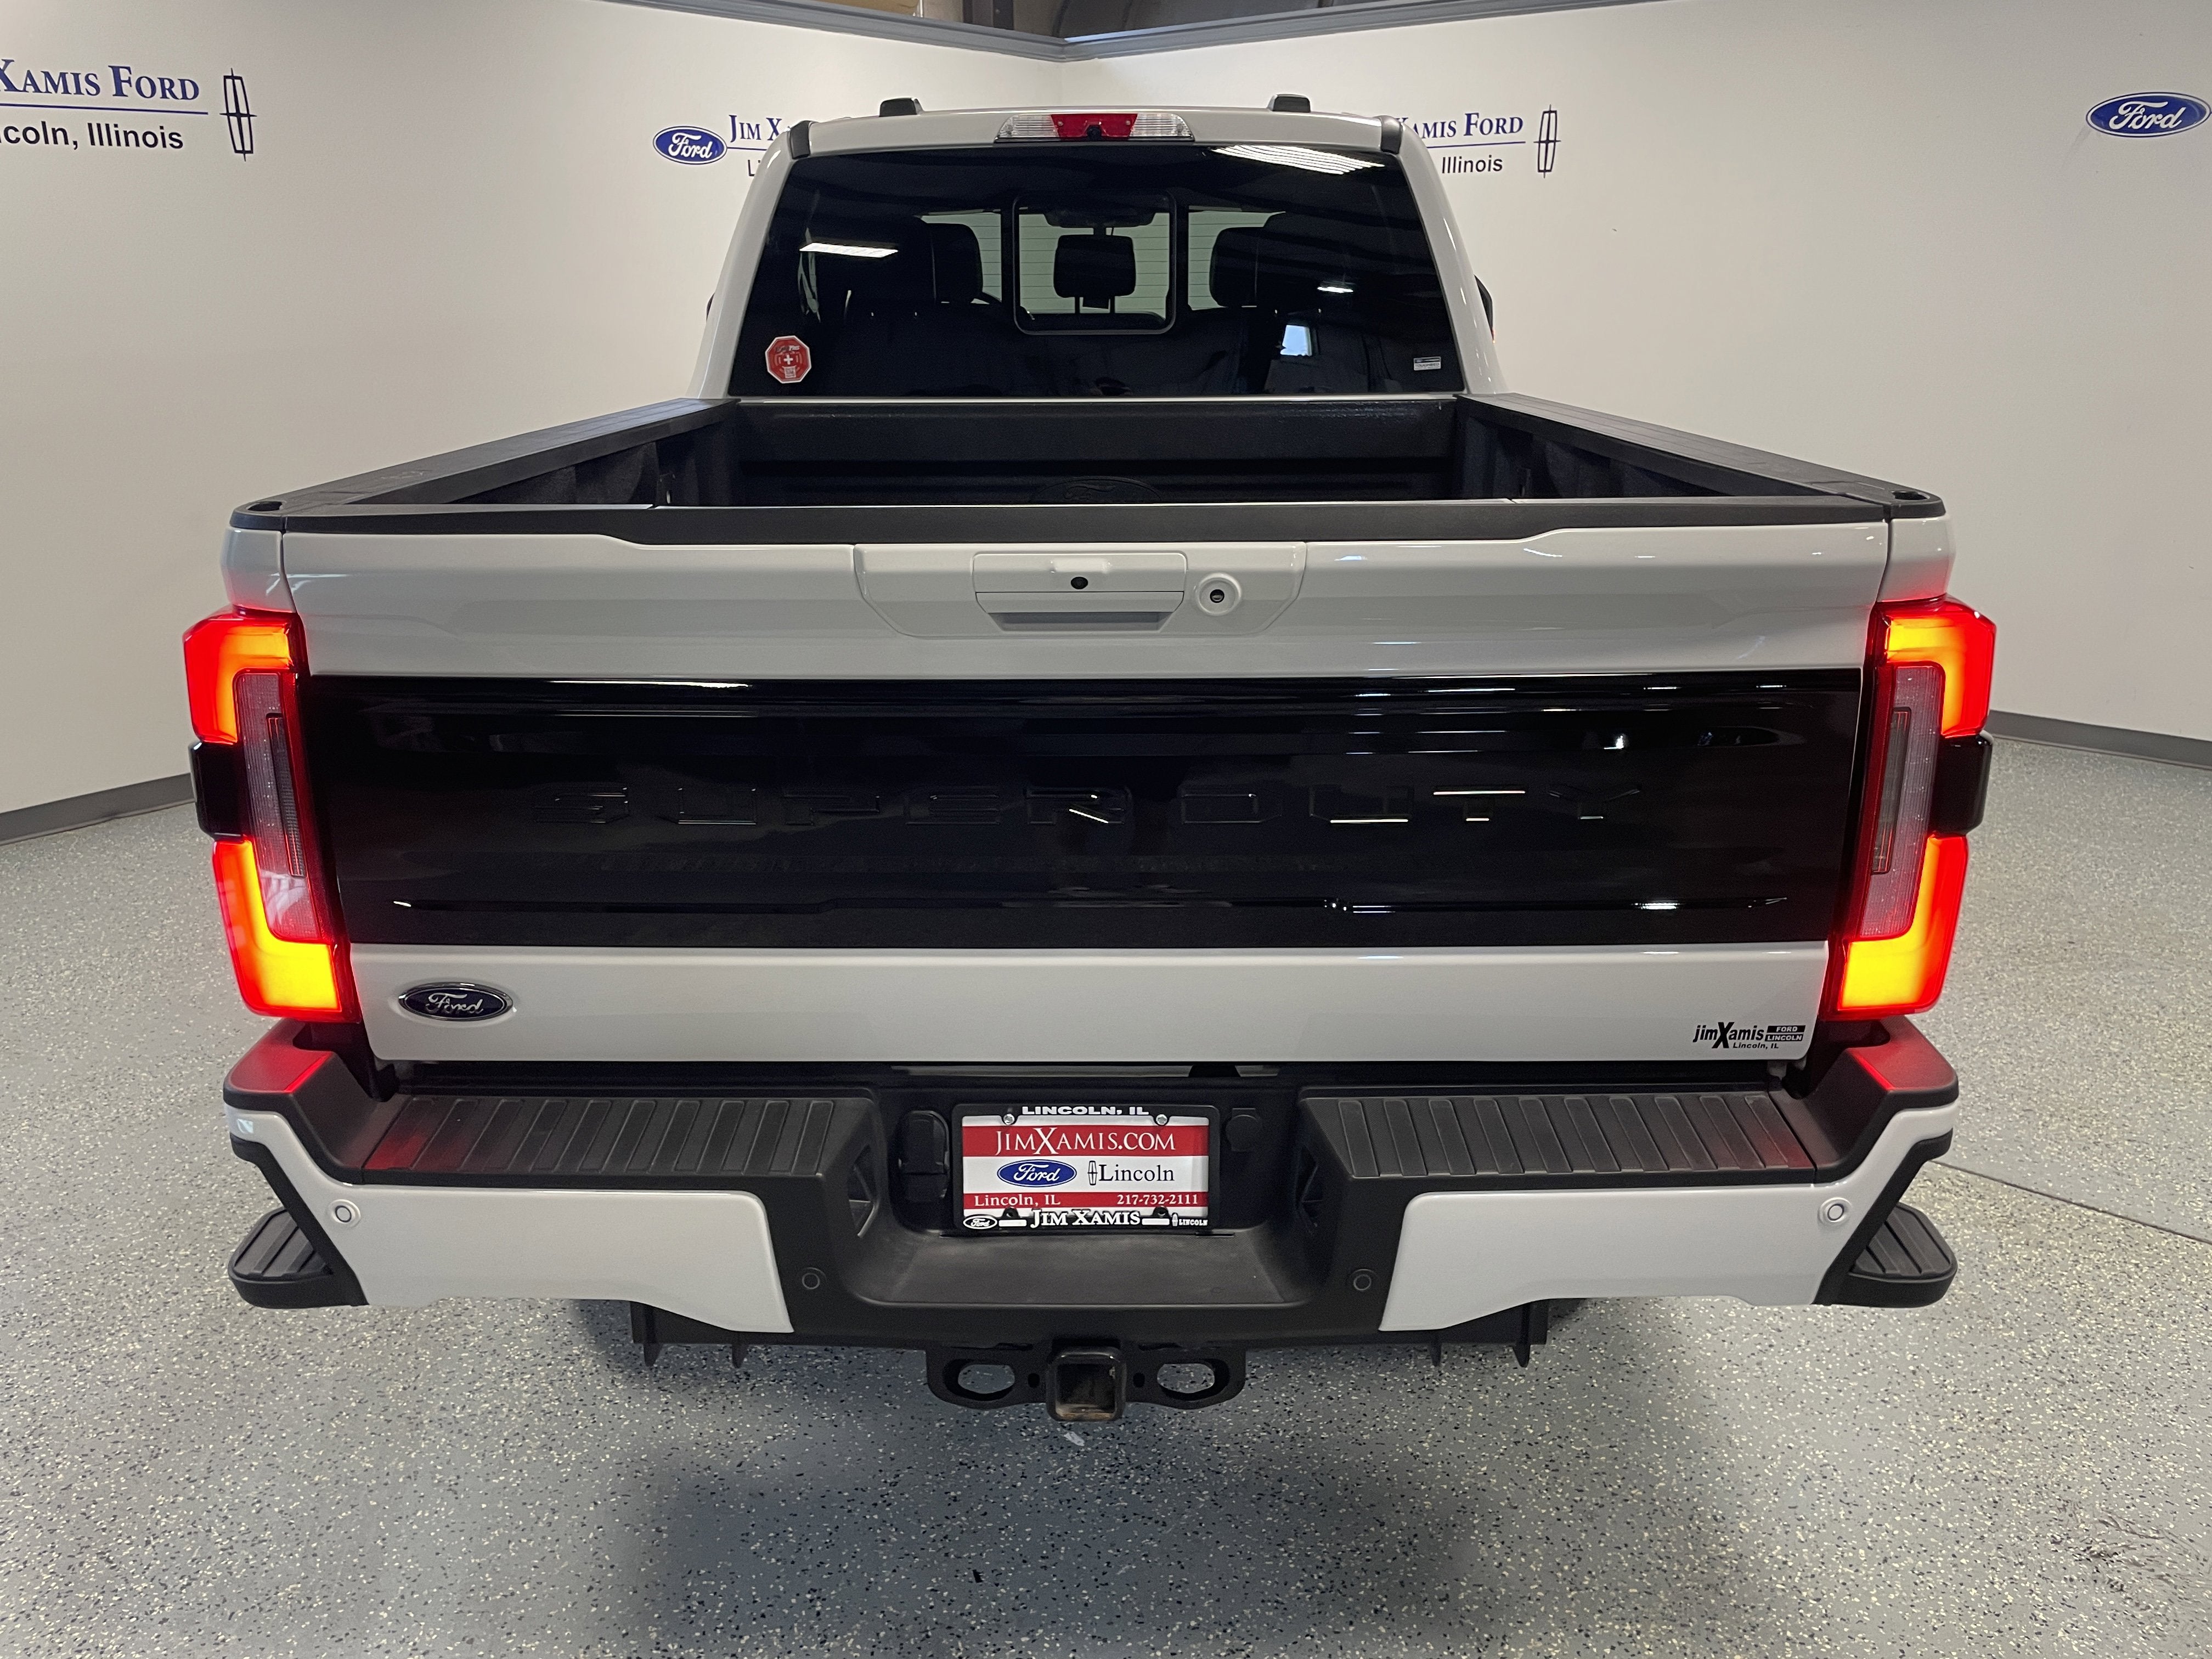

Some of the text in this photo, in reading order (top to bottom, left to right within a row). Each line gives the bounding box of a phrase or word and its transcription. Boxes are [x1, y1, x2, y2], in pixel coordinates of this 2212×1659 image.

[108, 65, 199, 100] FORD
[1464, 112, 1523, 136] FORD
[2109, 101, 2186, 129] Ford
[0, 121, 184, 150] coln, Illinois
[729, 114, 761, 143] JIM
[668, 132, 713, 159] Ford
[1442, 155, 1503, 173] Illinois
[425, 992, 484, 1014] Ford
[1023, 1106, 1149, 1115] LINCOLN, IL
[995, 1127, 1175, 1155] JIMXAMIS.COM
[1013, 1164, 1060, 1182] Ford
[1099, 1165, 1174, 1182] Lincoln
[974, 1194, 1061, 1206] Lincoln, IL
[1117, 1194, 1198, 1205] 217-732-2111
[1030, 1209, 1141, 1228] JIM XAMIS
